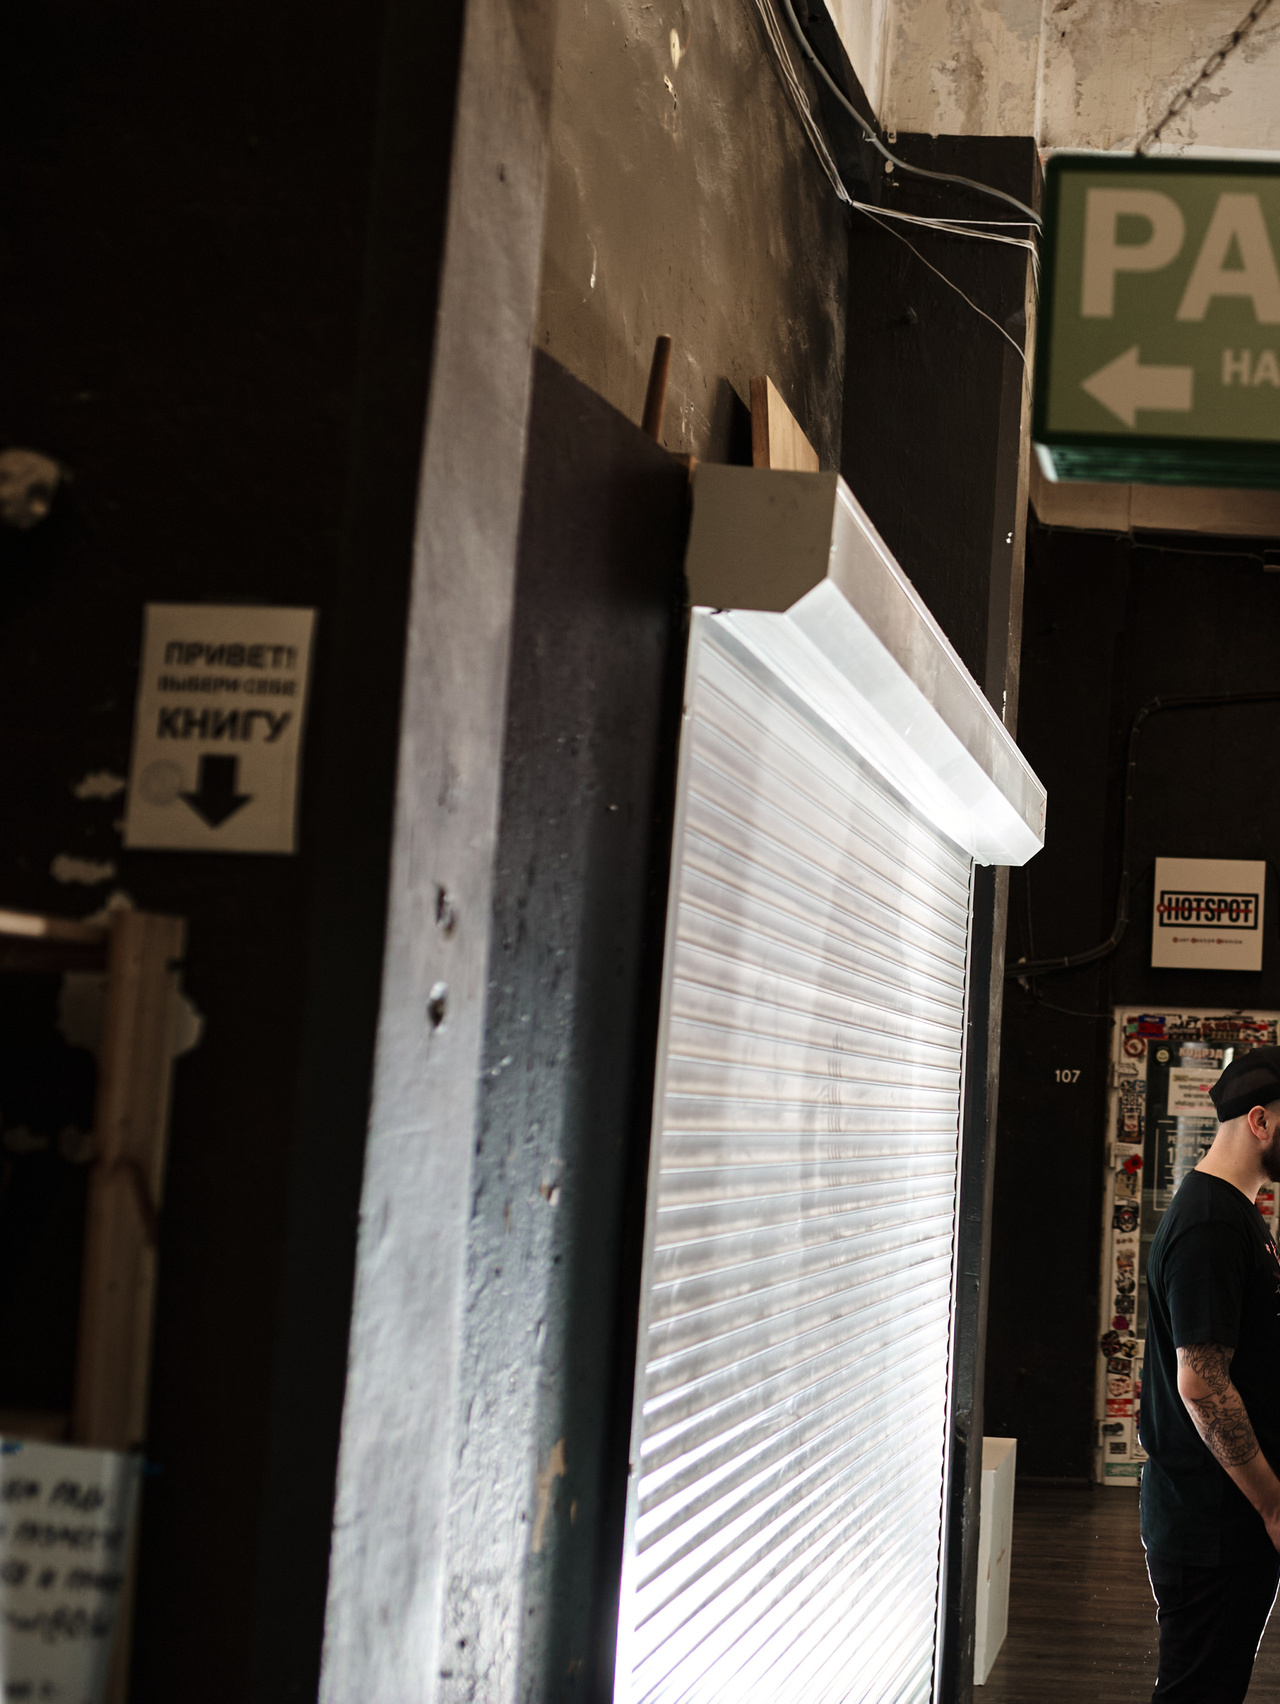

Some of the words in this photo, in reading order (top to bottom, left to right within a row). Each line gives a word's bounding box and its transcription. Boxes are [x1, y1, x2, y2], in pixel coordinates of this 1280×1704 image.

[164, 641, 296, 669] ПРИВЕТ!
[157, 706, 292, 743] КНИГУ
[1166, 896, 1253, 923] HOTSPOT
[1055, 1069, 1081, 1083] 107
